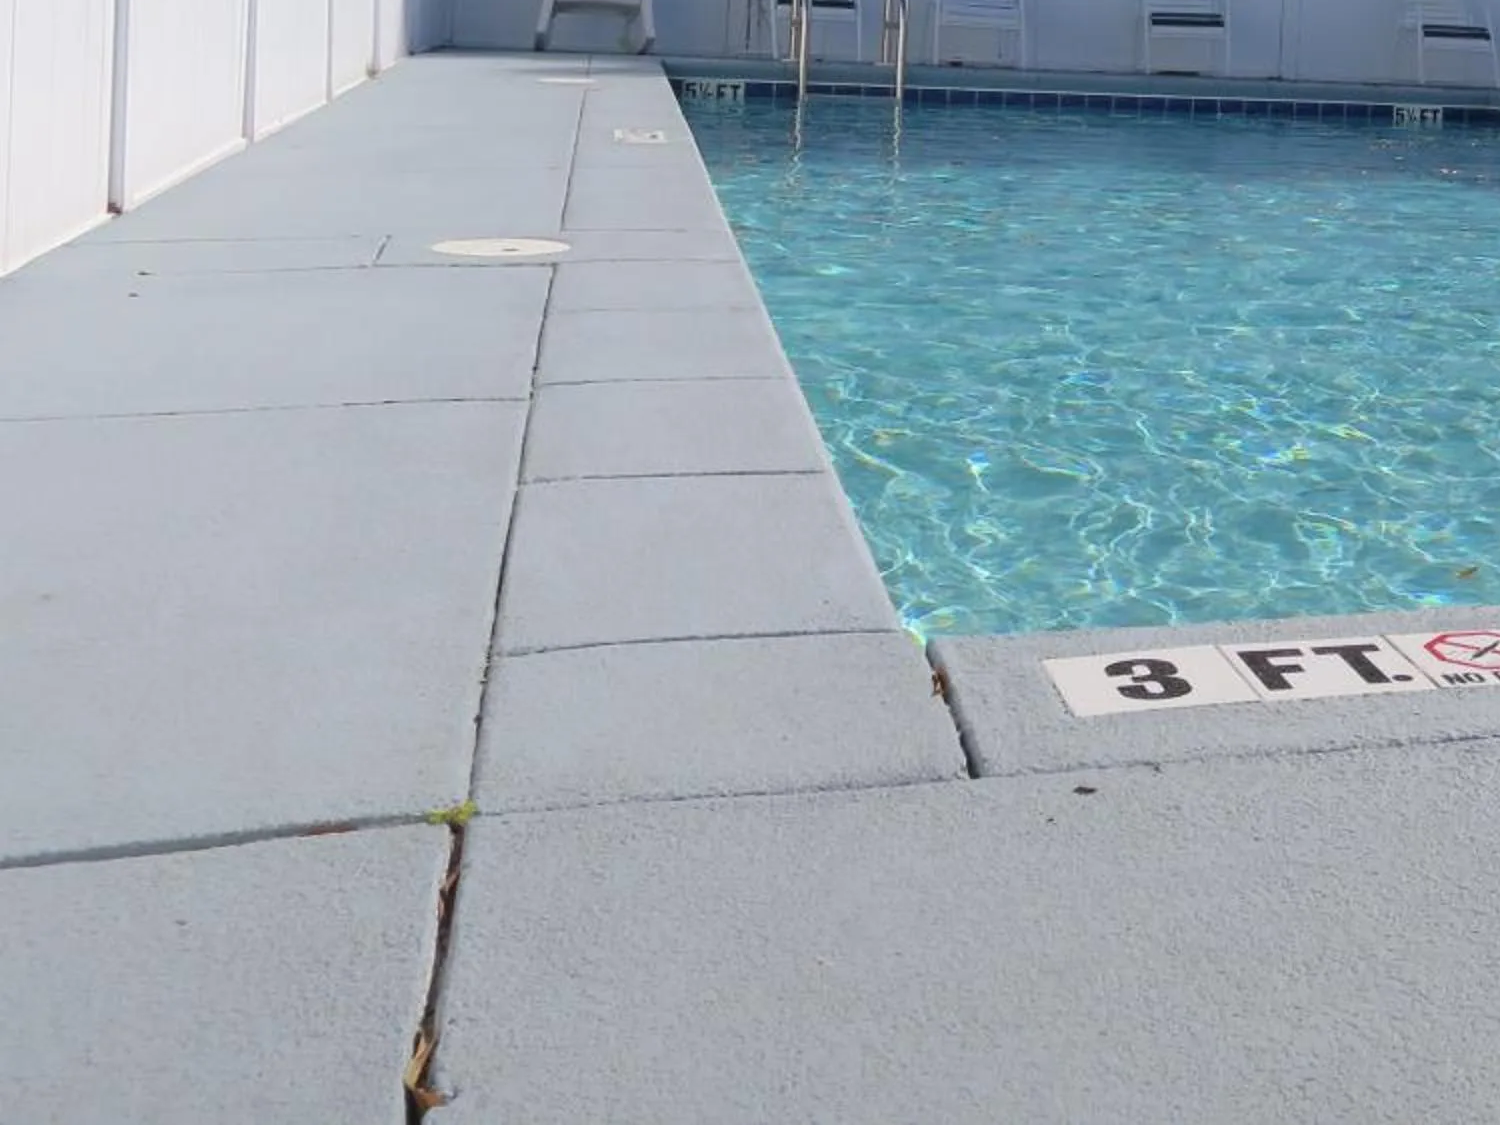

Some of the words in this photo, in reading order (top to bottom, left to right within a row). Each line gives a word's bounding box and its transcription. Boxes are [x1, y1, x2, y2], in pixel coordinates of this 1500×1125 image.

[1104, 658, 1193, 700] 3
[1237, 643, 1414, 691] FT.
[1441, 671, 1485, 686] NO
